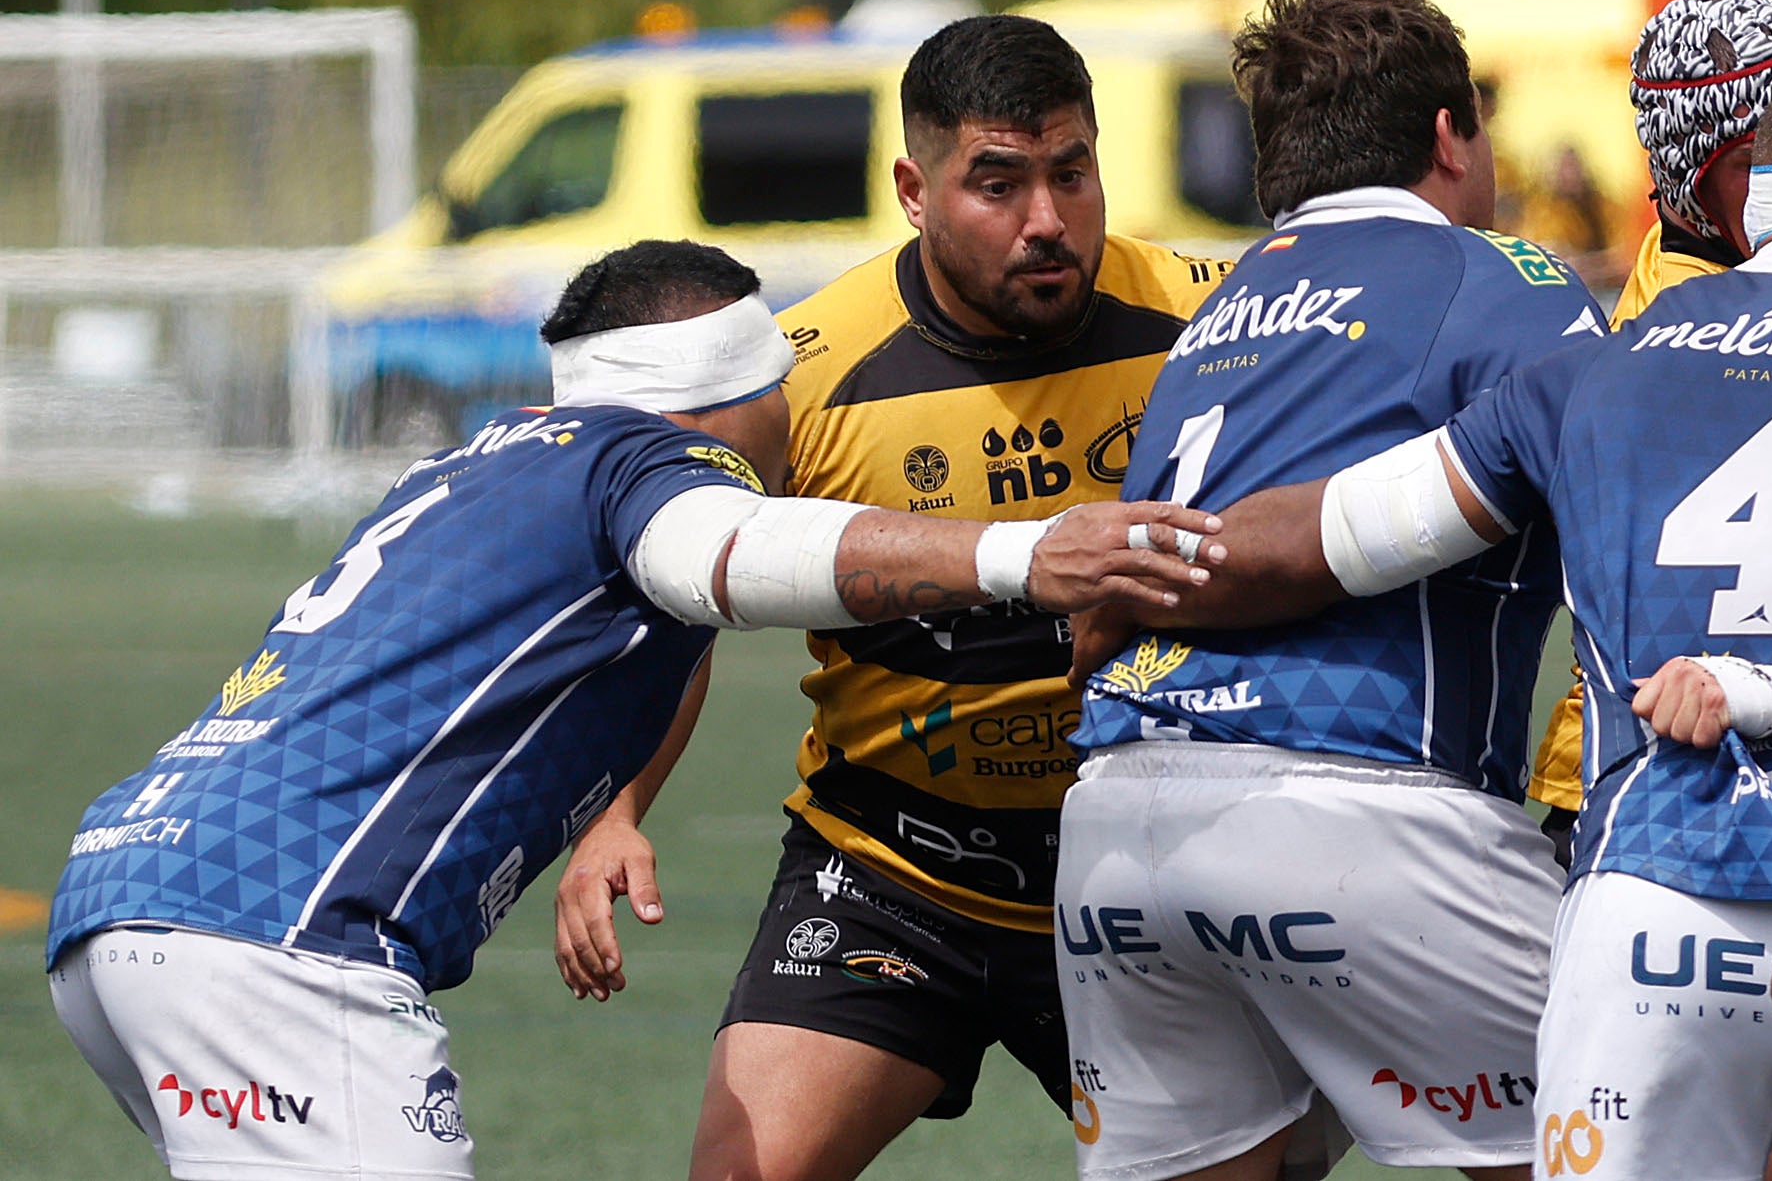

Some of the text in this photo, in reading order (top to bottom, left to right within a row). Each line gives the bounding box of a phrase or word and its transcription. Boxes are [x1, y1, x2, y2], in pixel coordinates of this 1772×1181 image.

[1196, 352, 1260, 376] PATATAS
[986, 457, 1023, 471] GRUPO
[987, 453, 1072, 506] nb
[1167, 404, 1225, 508] 1
[269, 483, 450, 634] 3
[970, 702, 1082, 753] caja
[972, 757, 1080, 779] Burgos
[1075, 1058, 1107, 1092] fit
[201, 1081, 315, 1129] cyltv
[1589, 1087, 1630, 1121] fit
[1543, 1110, 1603, 1179] GO
